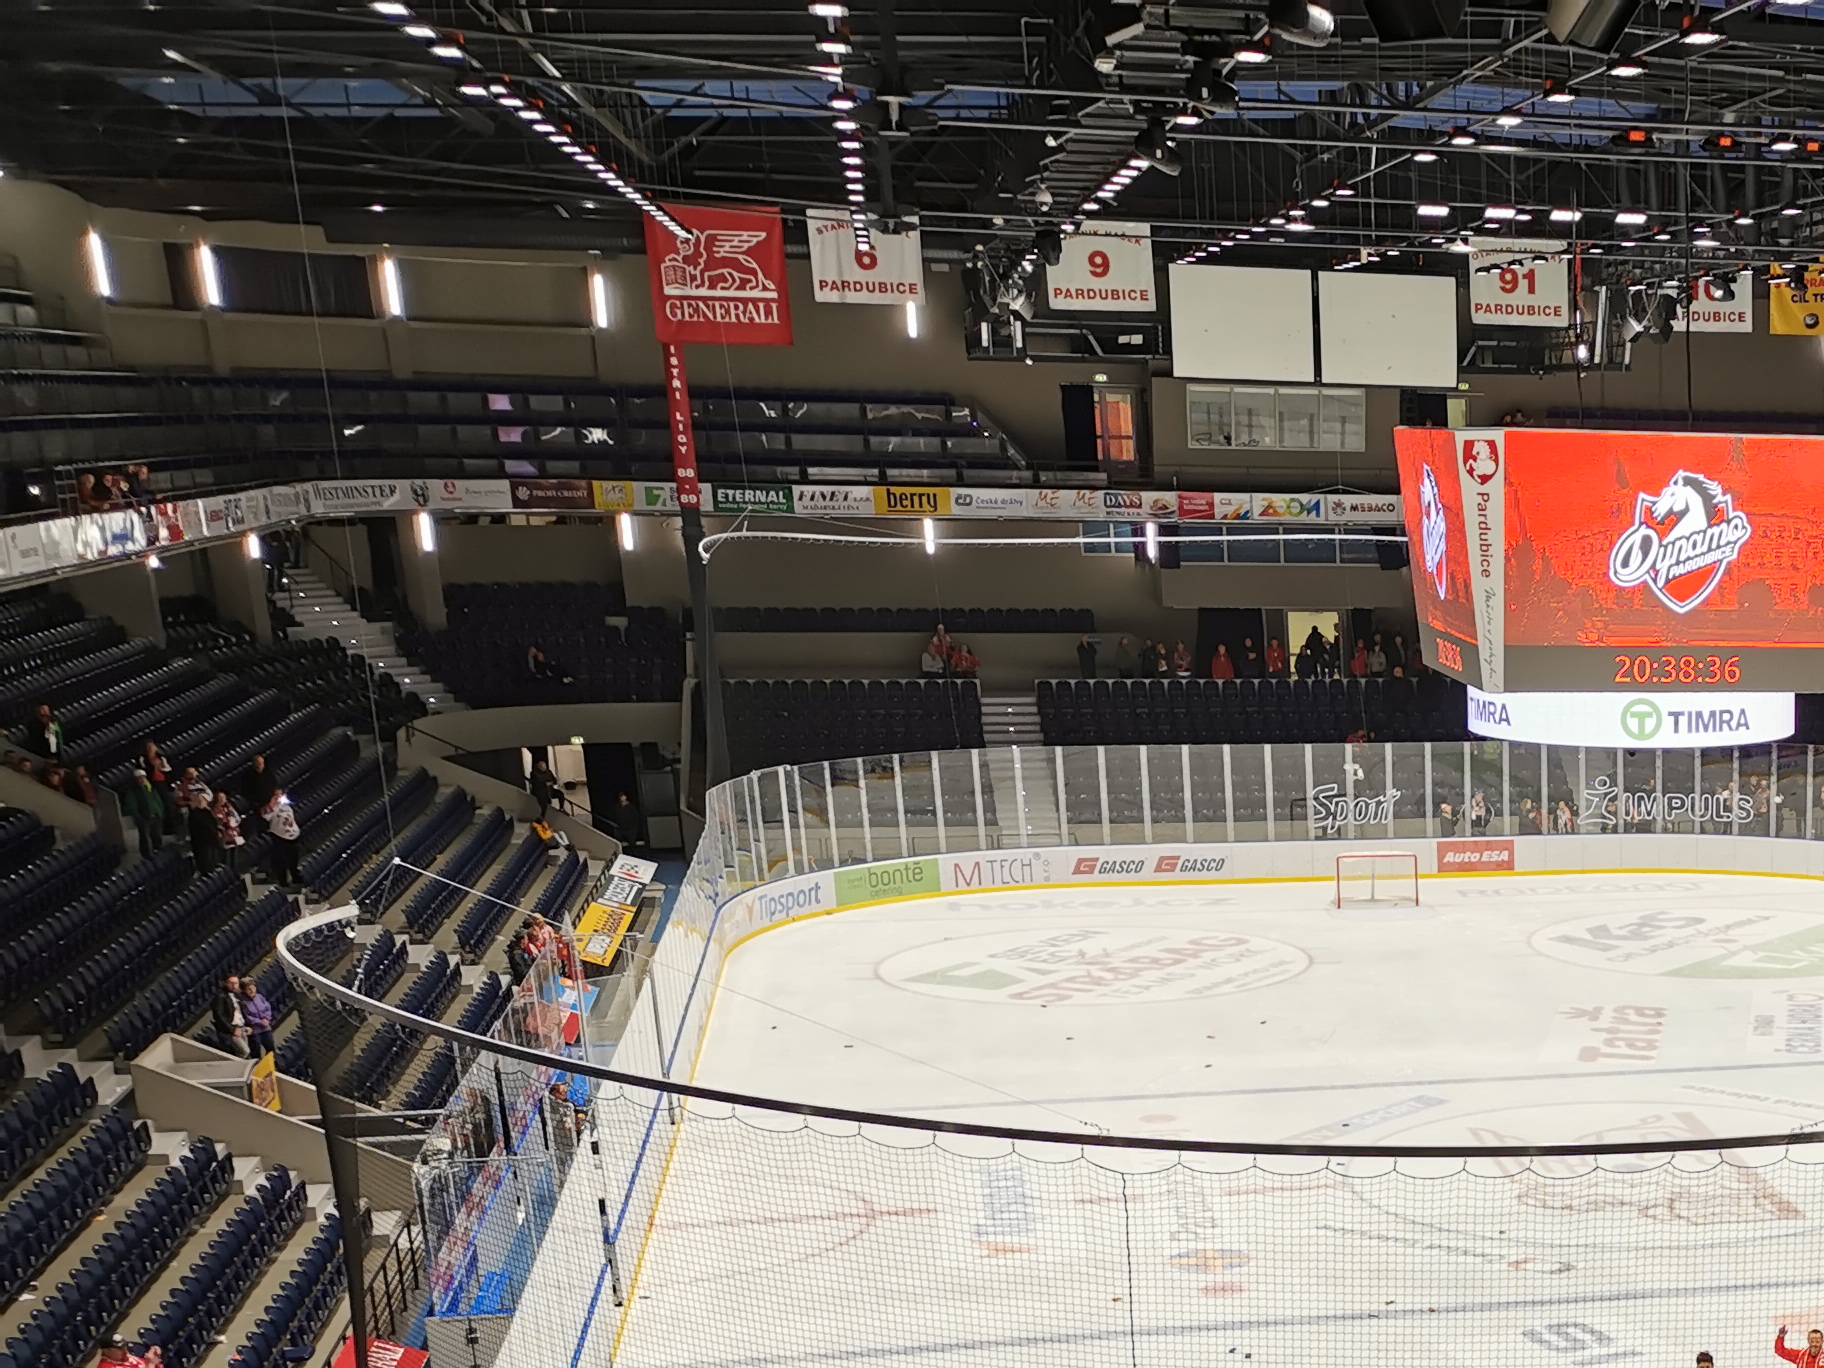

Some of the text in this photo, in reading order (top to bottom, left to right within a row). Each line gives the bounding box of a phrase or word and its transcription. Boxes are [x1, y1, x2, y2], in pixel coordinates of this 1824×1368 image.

[1087, 250, 1110, 278] 9
[818, 279, 919, 296] PARDUBICE
[1054, 287, 1149, 301] PARDUBICE
[1500, 269, 1536, 295] 91
[665, 299, 781, 324] GENERALI
[1474, 302, 1563, 317] PARDUBICE
[1674, 310, 1747, 323] ARDUBICE
[311, 482, 398, 502] WESTMINSTER
[717, 489, 787, 503] ETERNAL
[886, 488, 938, 513] berry
[1104, 492, 1143, 509] DAYS
[1350, 502, 1396, 513] MEBACO
[1475, 491, 1493, 579] Pardubice
[1611, 512, 1750, 588] Dynamo
[1669, 543, 1734, 579] PARDUBICE
[1614, 654, 1742, 684] 20:38:36
[1469, 697, 1512, 727] TIMRA
[1667, 708, 1751, 734] TIMRA
[1312, 783, 1402, 834] Sport
[1622, 792, 1755, 823] IMPULS
[1098, 860, 1146, 875] GASCO
[1179, 858, 1226, 873] GASCO
[1443, 850, 1510, 865] Auto ESA
[758, 882, 821, 922] Tipsport
[1006, 935, 1251, 1004] STRABAG
